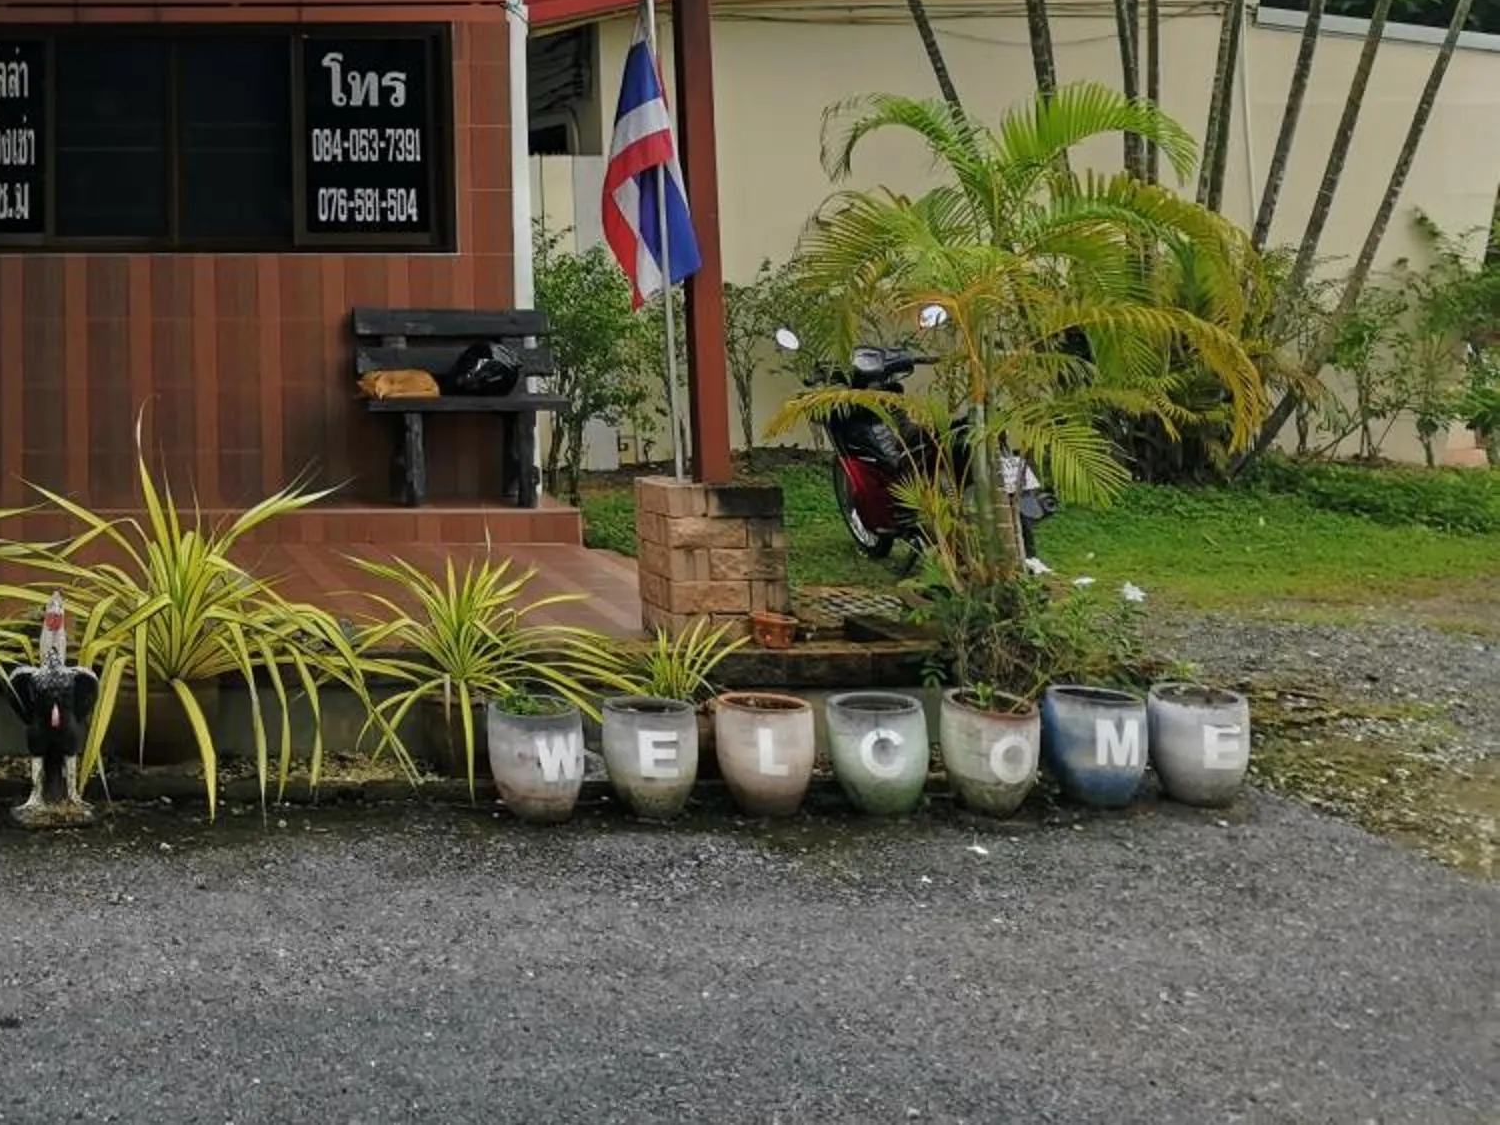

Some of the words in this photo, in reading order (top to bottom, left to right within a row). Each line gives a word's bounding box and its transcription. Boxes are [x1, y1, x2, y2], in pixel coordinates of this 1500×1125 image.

[321, 52, 407, 107] โทร
[312, 128, 421, 162] 084-053-7391
[318, 187, 418, 222] 076-581-504
[536, 719, 1243, 783] WELCOME
